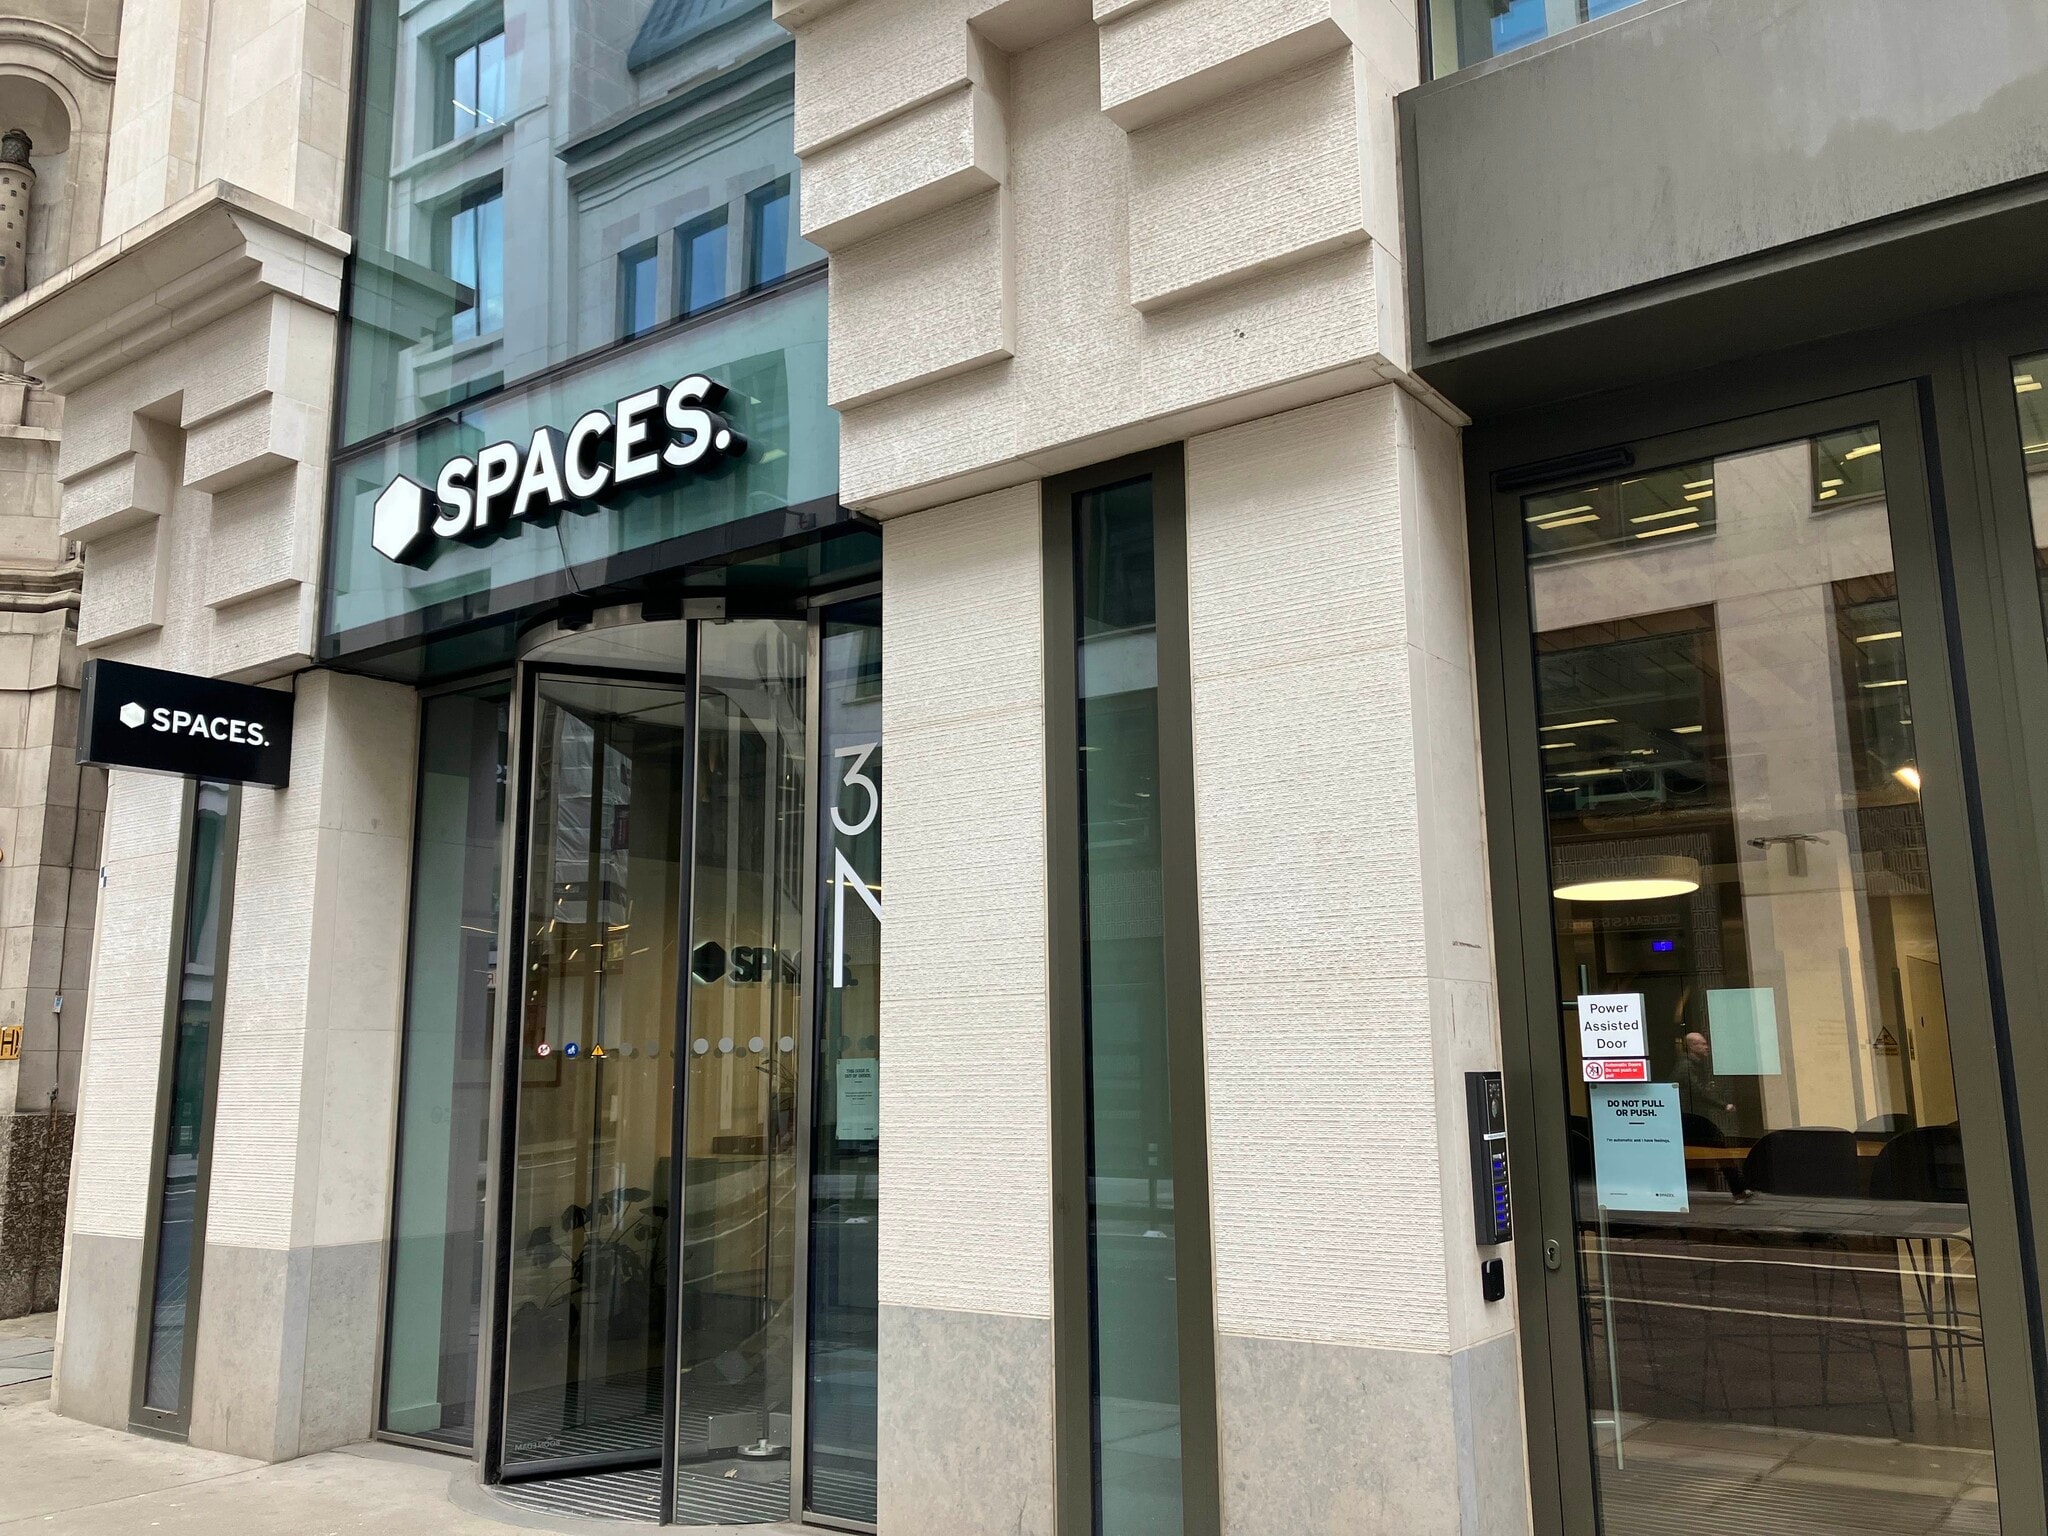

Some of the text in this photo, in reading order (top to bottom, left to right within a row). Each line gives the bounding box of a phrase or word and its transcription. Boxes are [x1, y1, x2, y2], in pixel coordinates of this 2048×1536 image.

[431, 373, 732, 537] SPACES.
[151, 707, 270, 747] SPACES.
[1590, 1003, 1629, 1014] Power
[1584, 1019, 1640, 1032] Assisted
[1596, 1038, 1628, 1049] Door
